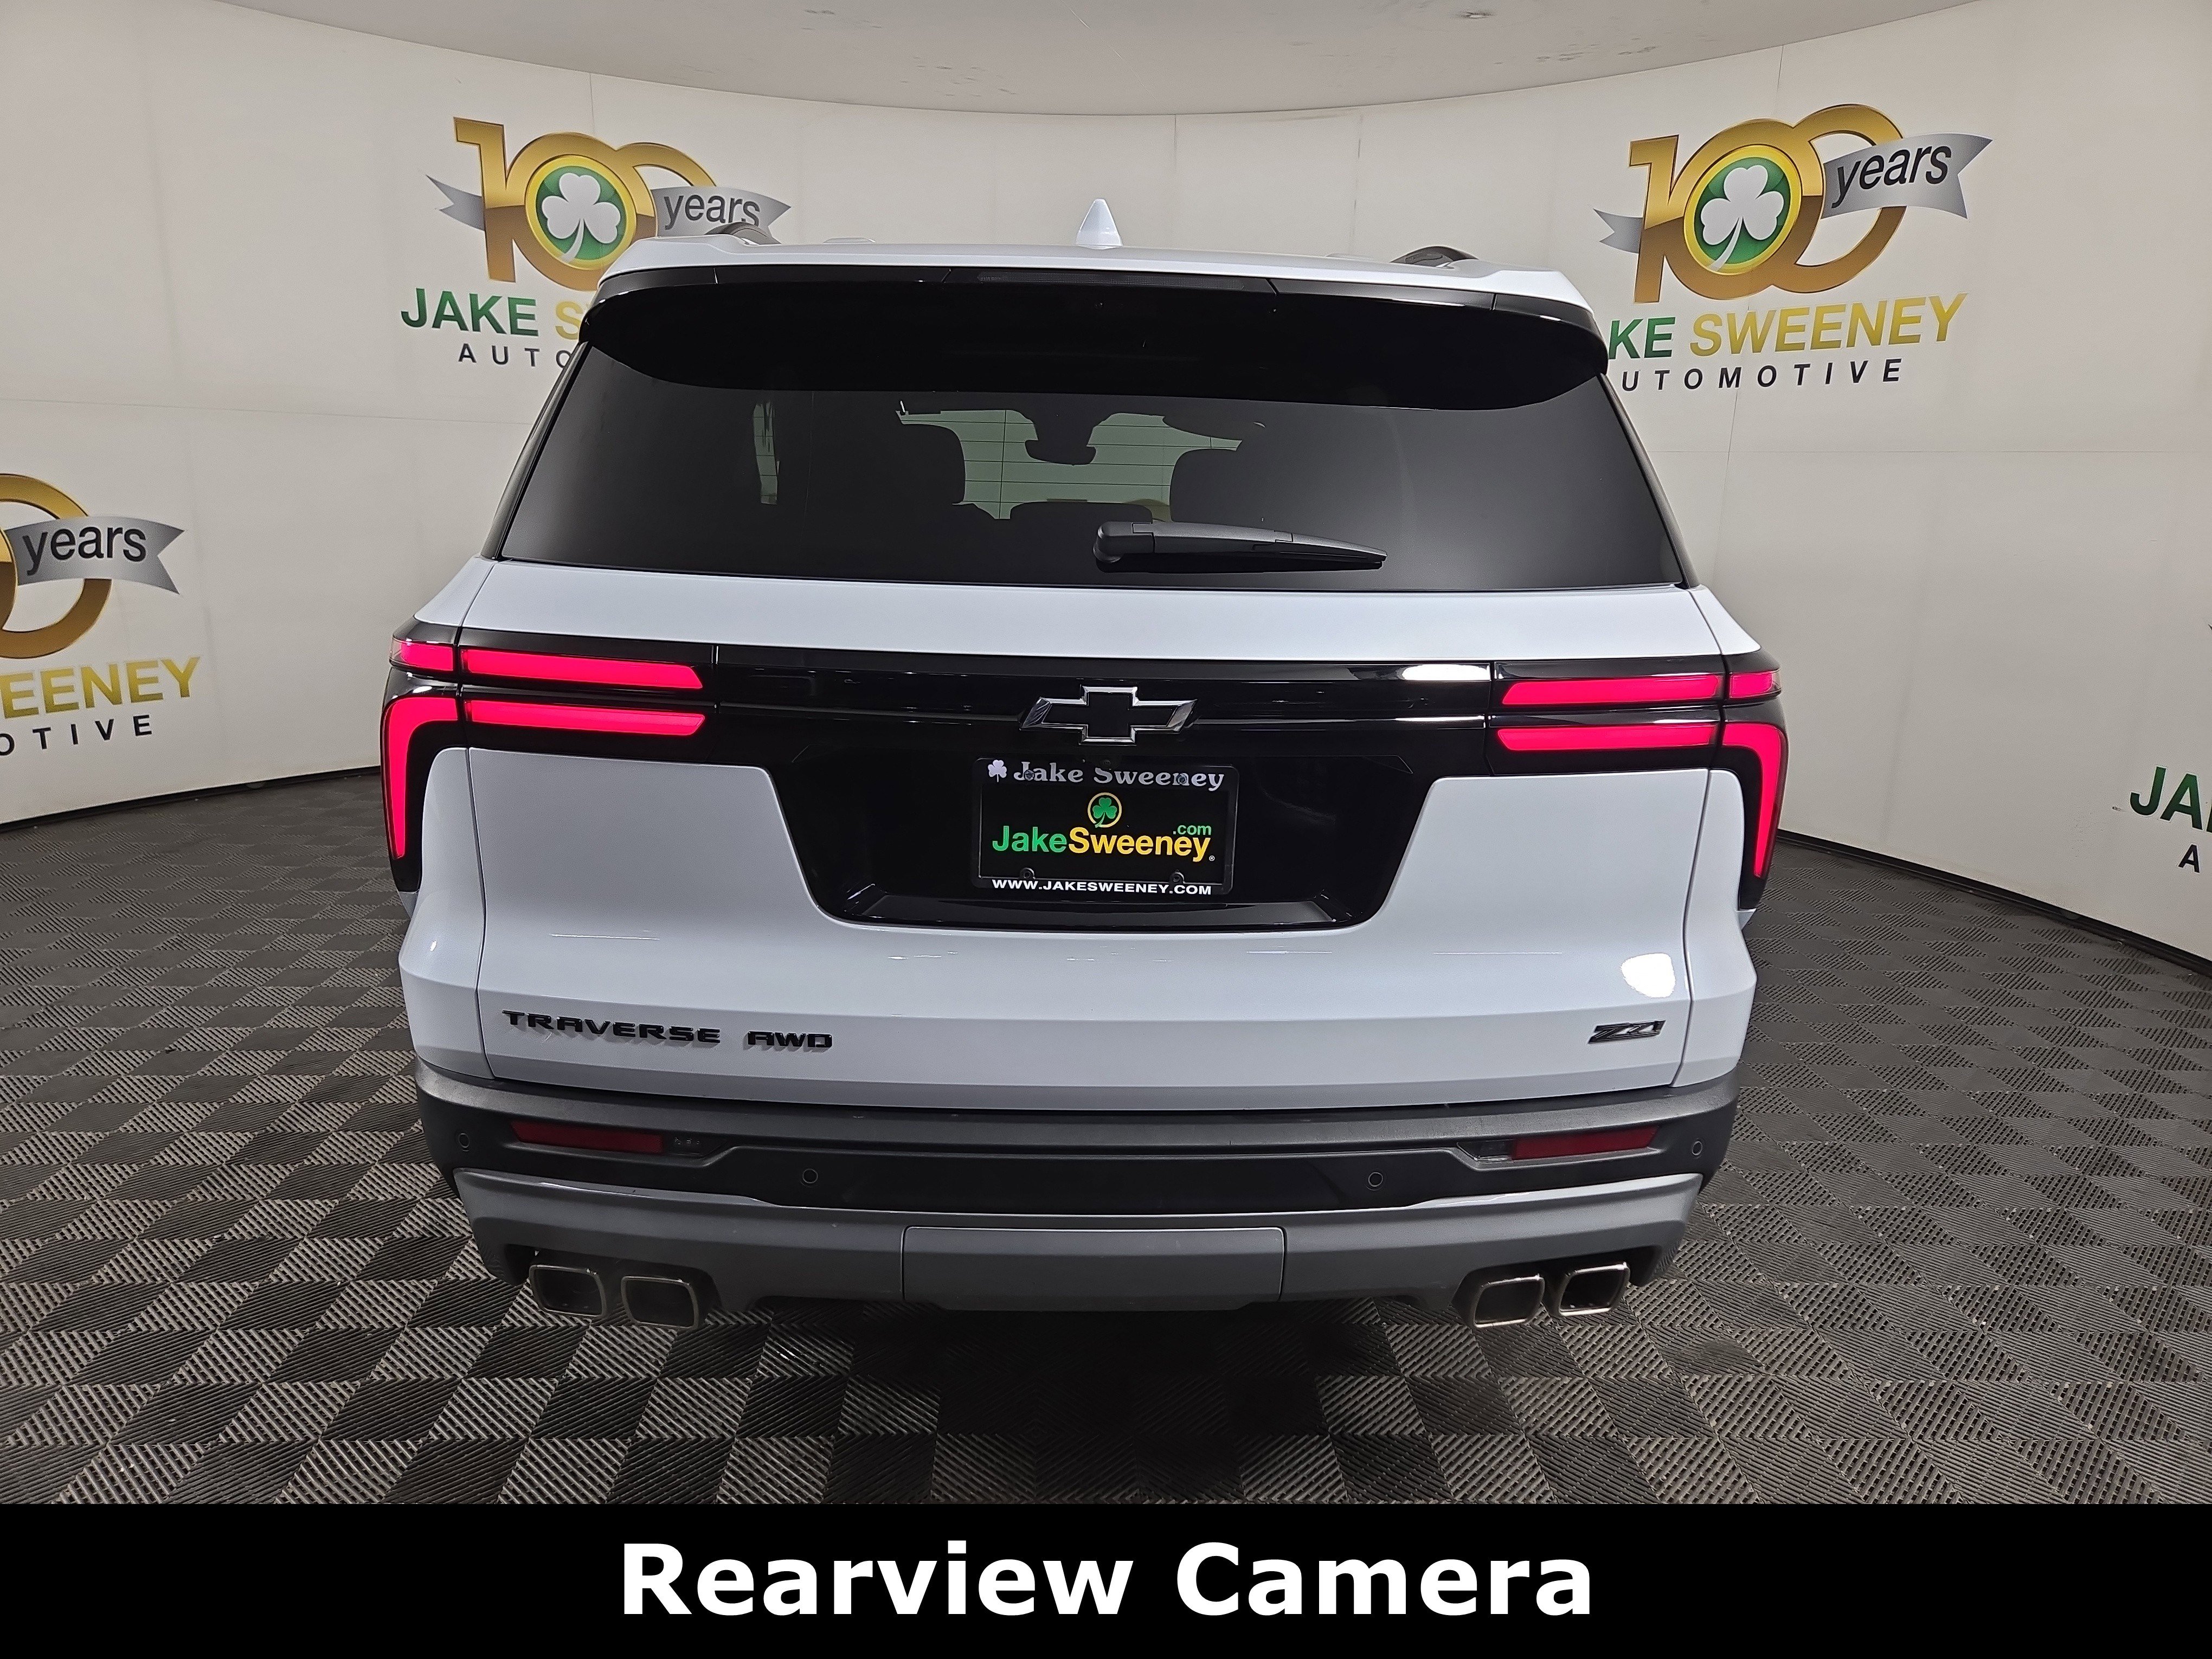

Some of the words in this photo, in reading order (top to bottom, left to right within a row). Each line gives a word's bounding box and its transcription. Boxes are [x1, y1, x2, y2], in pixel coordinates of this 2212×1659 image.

[1831, 145, 1952, 209] years
[664, 194, 760, 230] years
[401, 288, 539, 337] JAKE
[555, 301, 590, 340] S
[1690, 293, 1969, 358] SWEENEY
[1622, 358, 1902, 392] UTOMOTIVE
[23, 526, 147, 576] years
[0, 656, 202, 719] EENEY
[1013, 761, 1084, 783] Jake
[1093, 767, 1225, 791] Sweeney
[2130, 766, 2212, 833] JA
[1173, 823, 1212, 835] .com
[992, 879, 1211, 896] WWW.JAKESWEENEY.COM
[502, 1009, 721, 1044] TRAVERSE
[748, 1031, 833, 1048] AWD
